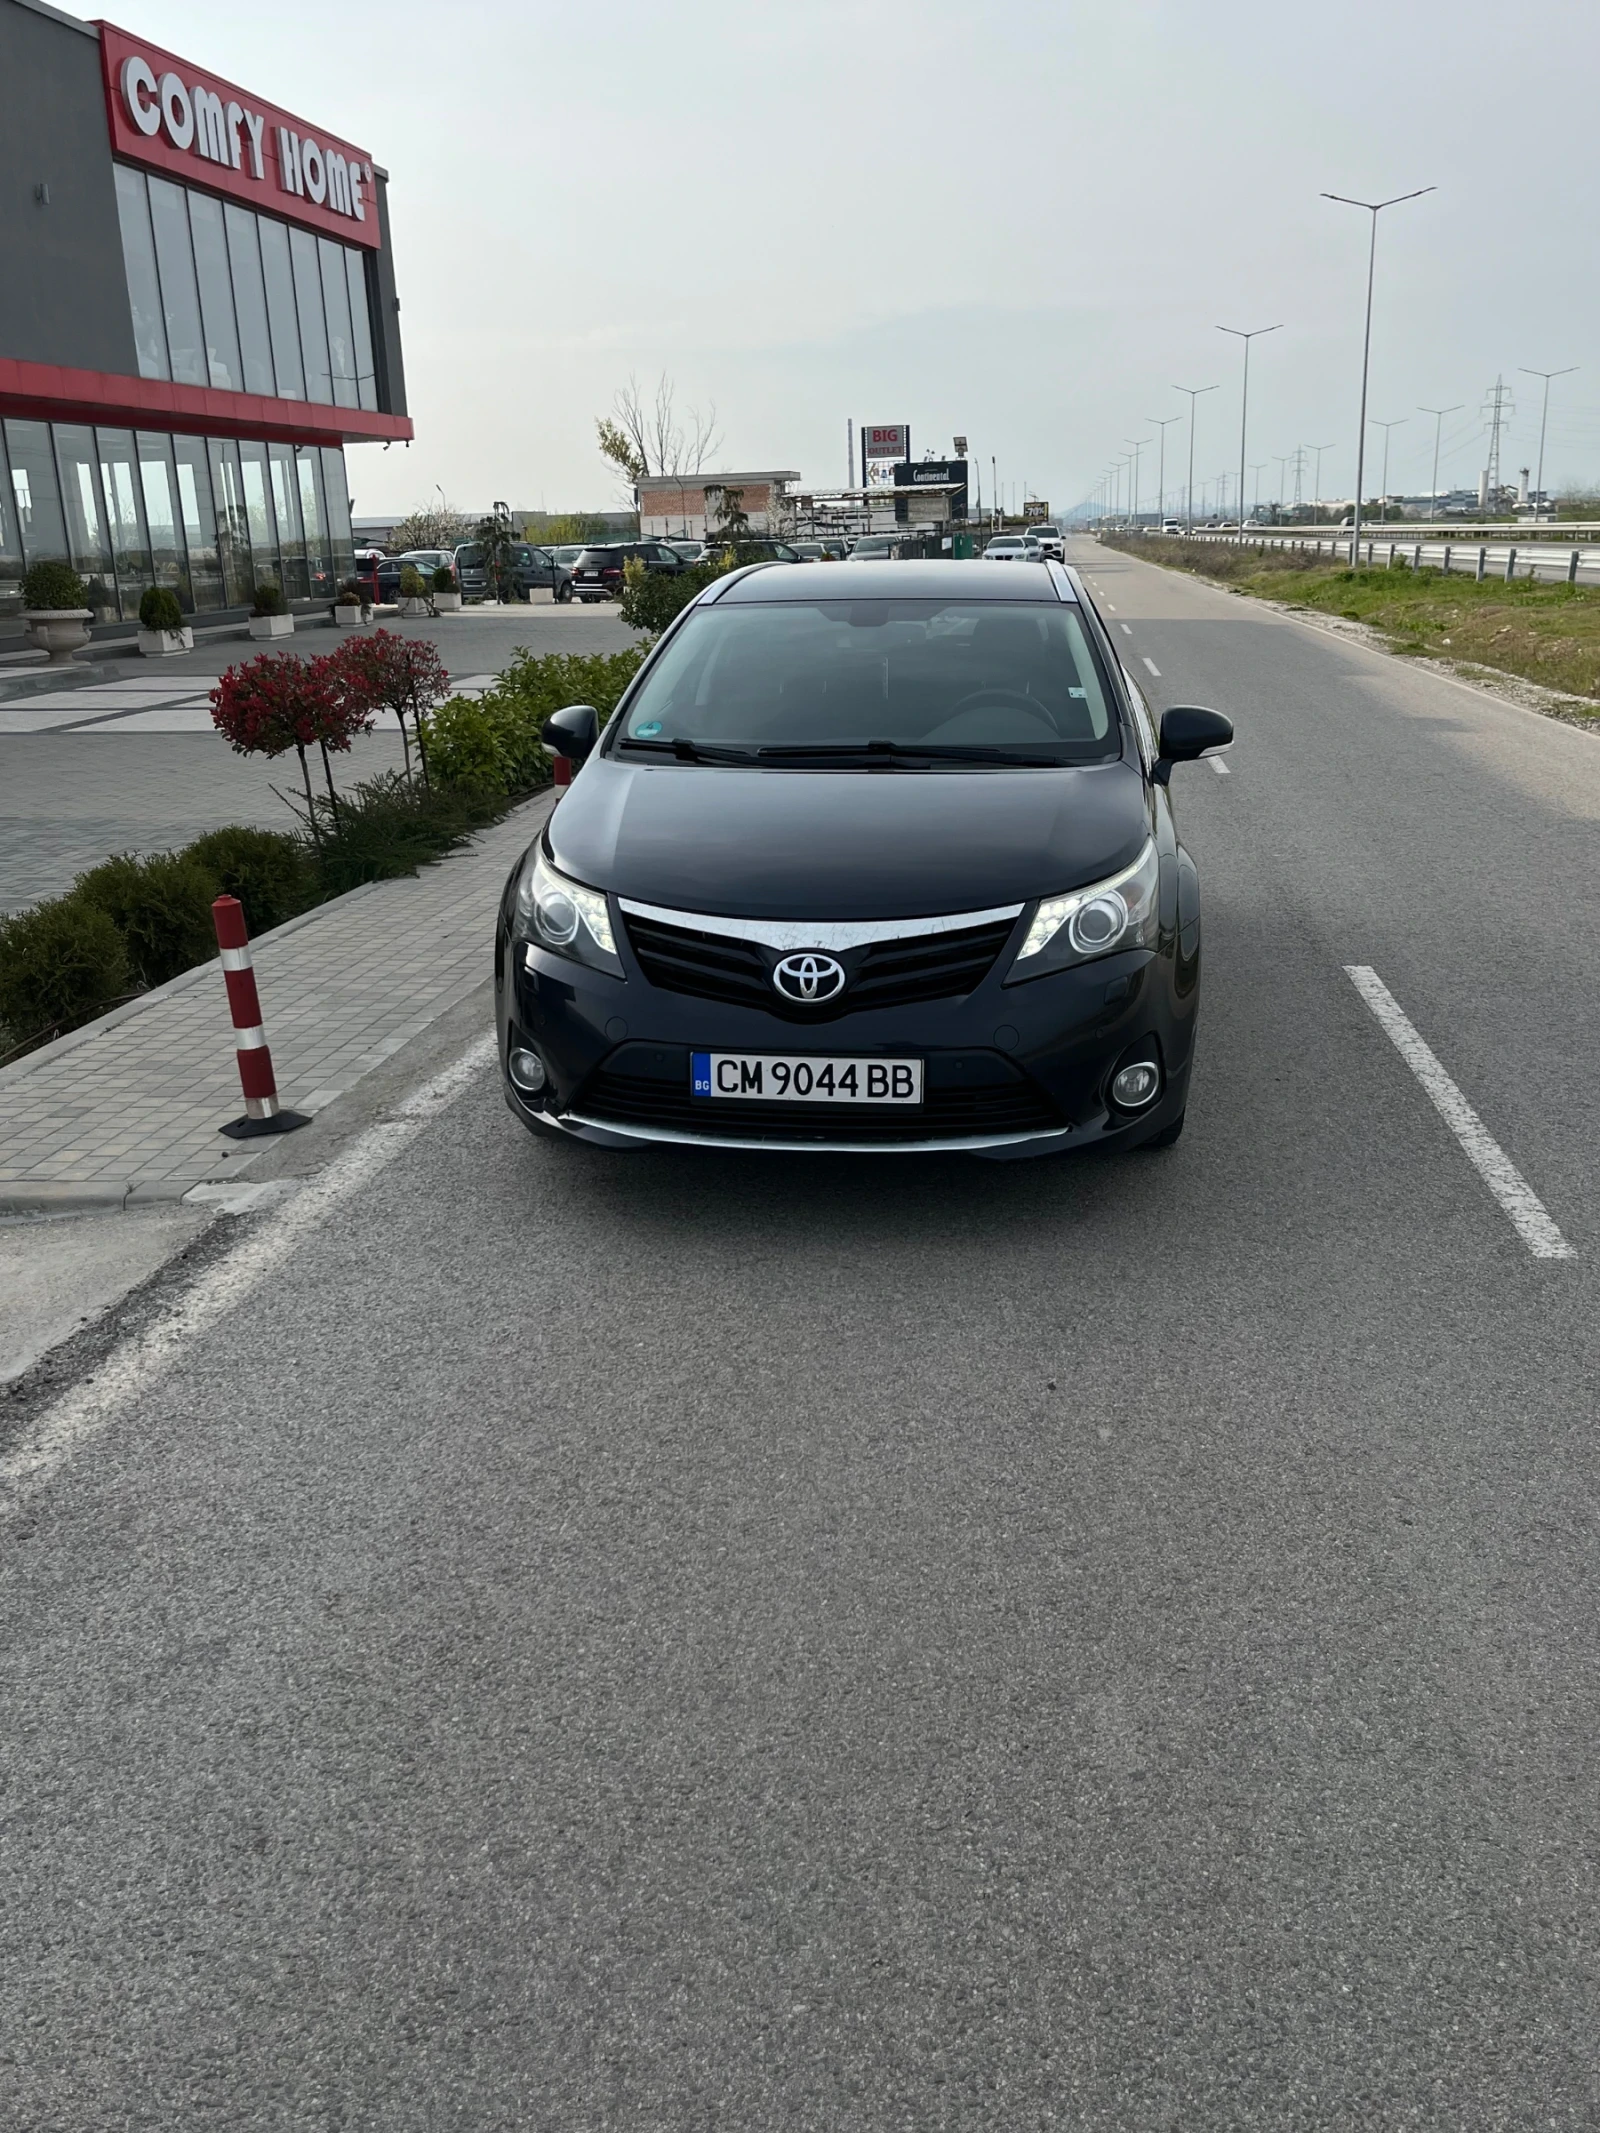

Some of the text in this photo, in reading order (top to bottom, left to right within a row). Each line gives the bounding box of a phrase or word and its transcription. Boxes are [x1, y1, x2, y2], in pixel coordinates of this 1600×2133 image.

[120, 56, 365, 221] COMFY HOME
[872, 428, 898, 442] BIG
[868, 446, 903, 455] OUTLET
[913, 468, 950, 482] Continental
[694, 1080, 710, 1091] BG
